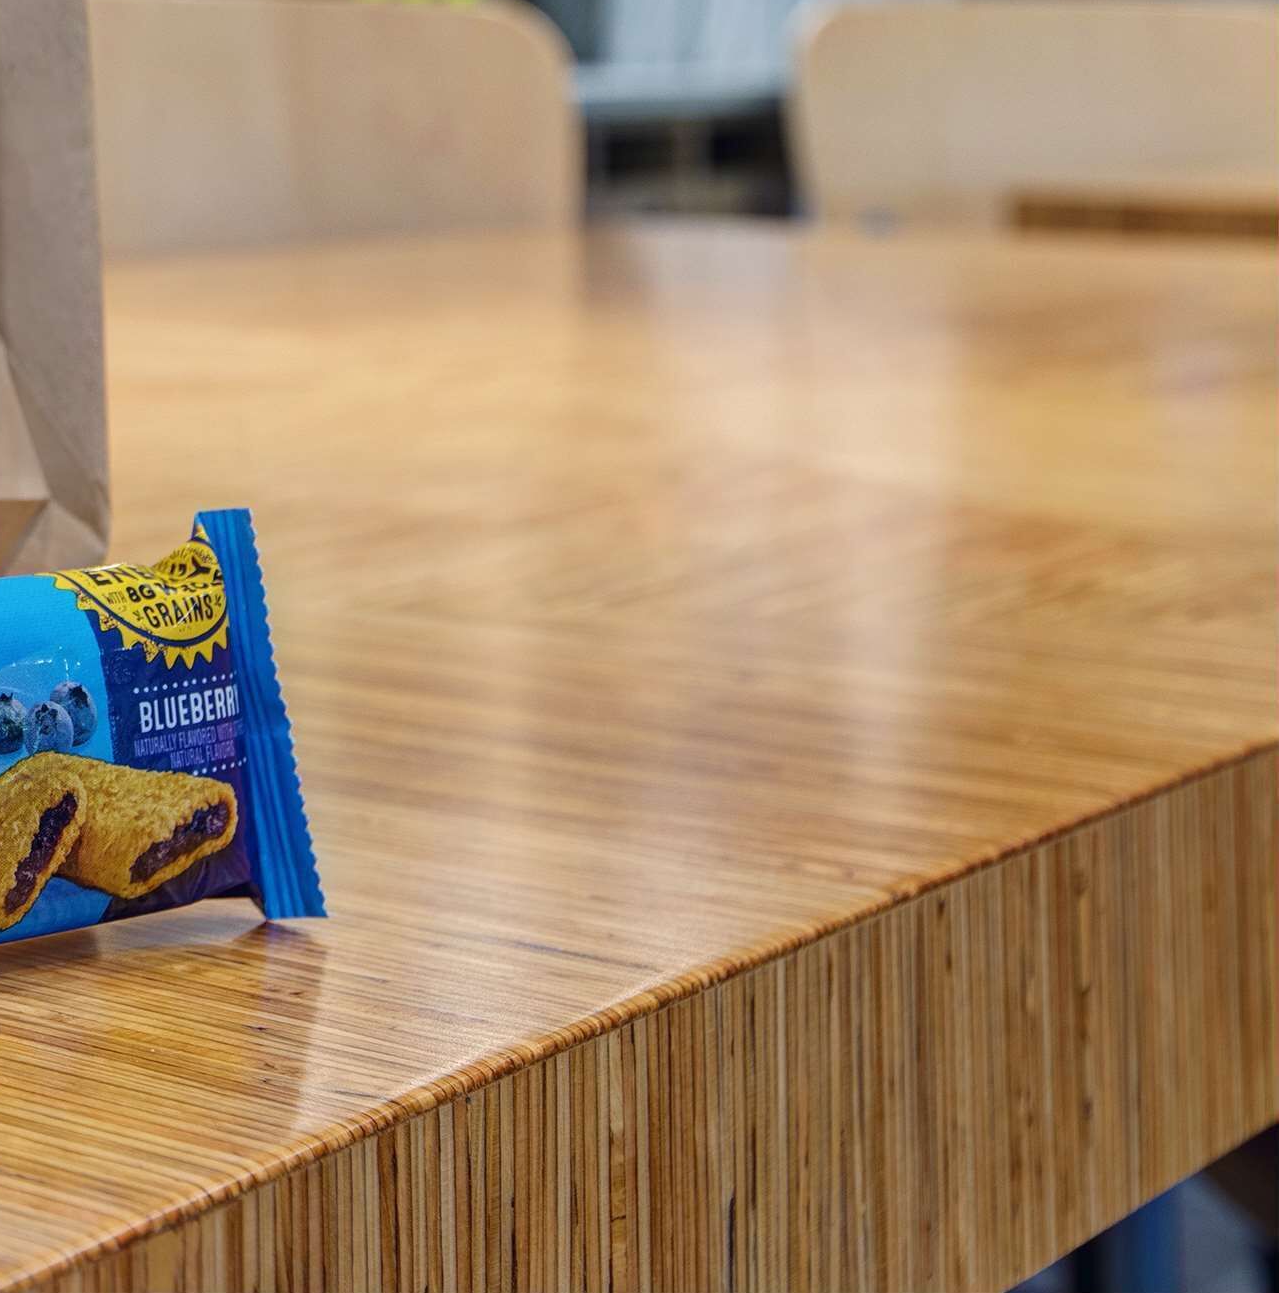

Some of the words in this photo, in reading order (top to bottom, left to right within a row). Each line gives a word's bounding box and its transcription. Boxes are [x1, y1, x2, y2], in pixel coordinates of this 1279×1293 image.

[142, 593, 215, 629] GRAINS
[133, 732, 178, 758] NATURALLY
[178, 725, 217, 750] FLAVORED
[170, 747, 204, 769] NATURAL
